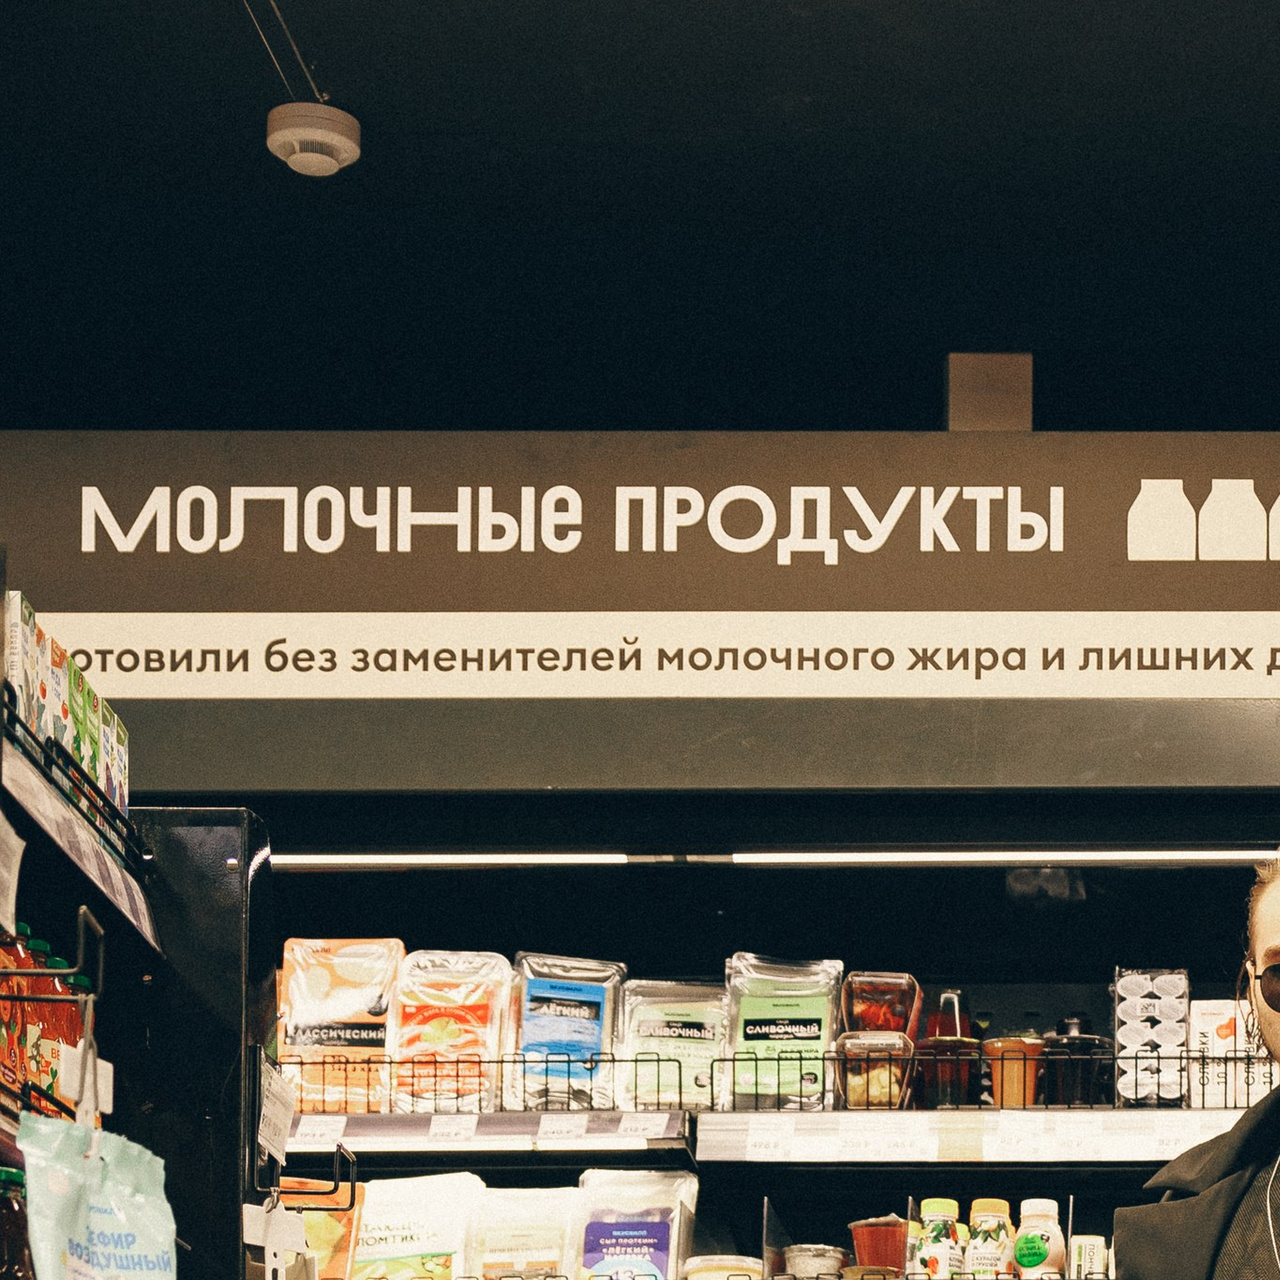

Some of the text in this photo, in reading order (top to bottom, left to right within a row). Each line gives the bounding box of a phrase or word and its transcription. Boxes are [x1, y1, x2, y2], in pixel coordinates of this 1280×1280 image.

[615, 485, 1065, 565] ПРОДУКТЫ
[264, 638, 337, 673] без
[350, 636, 643, 673] заменителей
[657, 645, 896, 672] молочного
[906, 645, 1027, 679] жира
[1041, 645, 1065, 672] и
[1078, 645, 1254, 672] лишних
[745, 1022, 820, 1037] СЛИВОЧНЫЙ
[68, 1236, 172, 1273] ВОЗДУШНЫЙ
